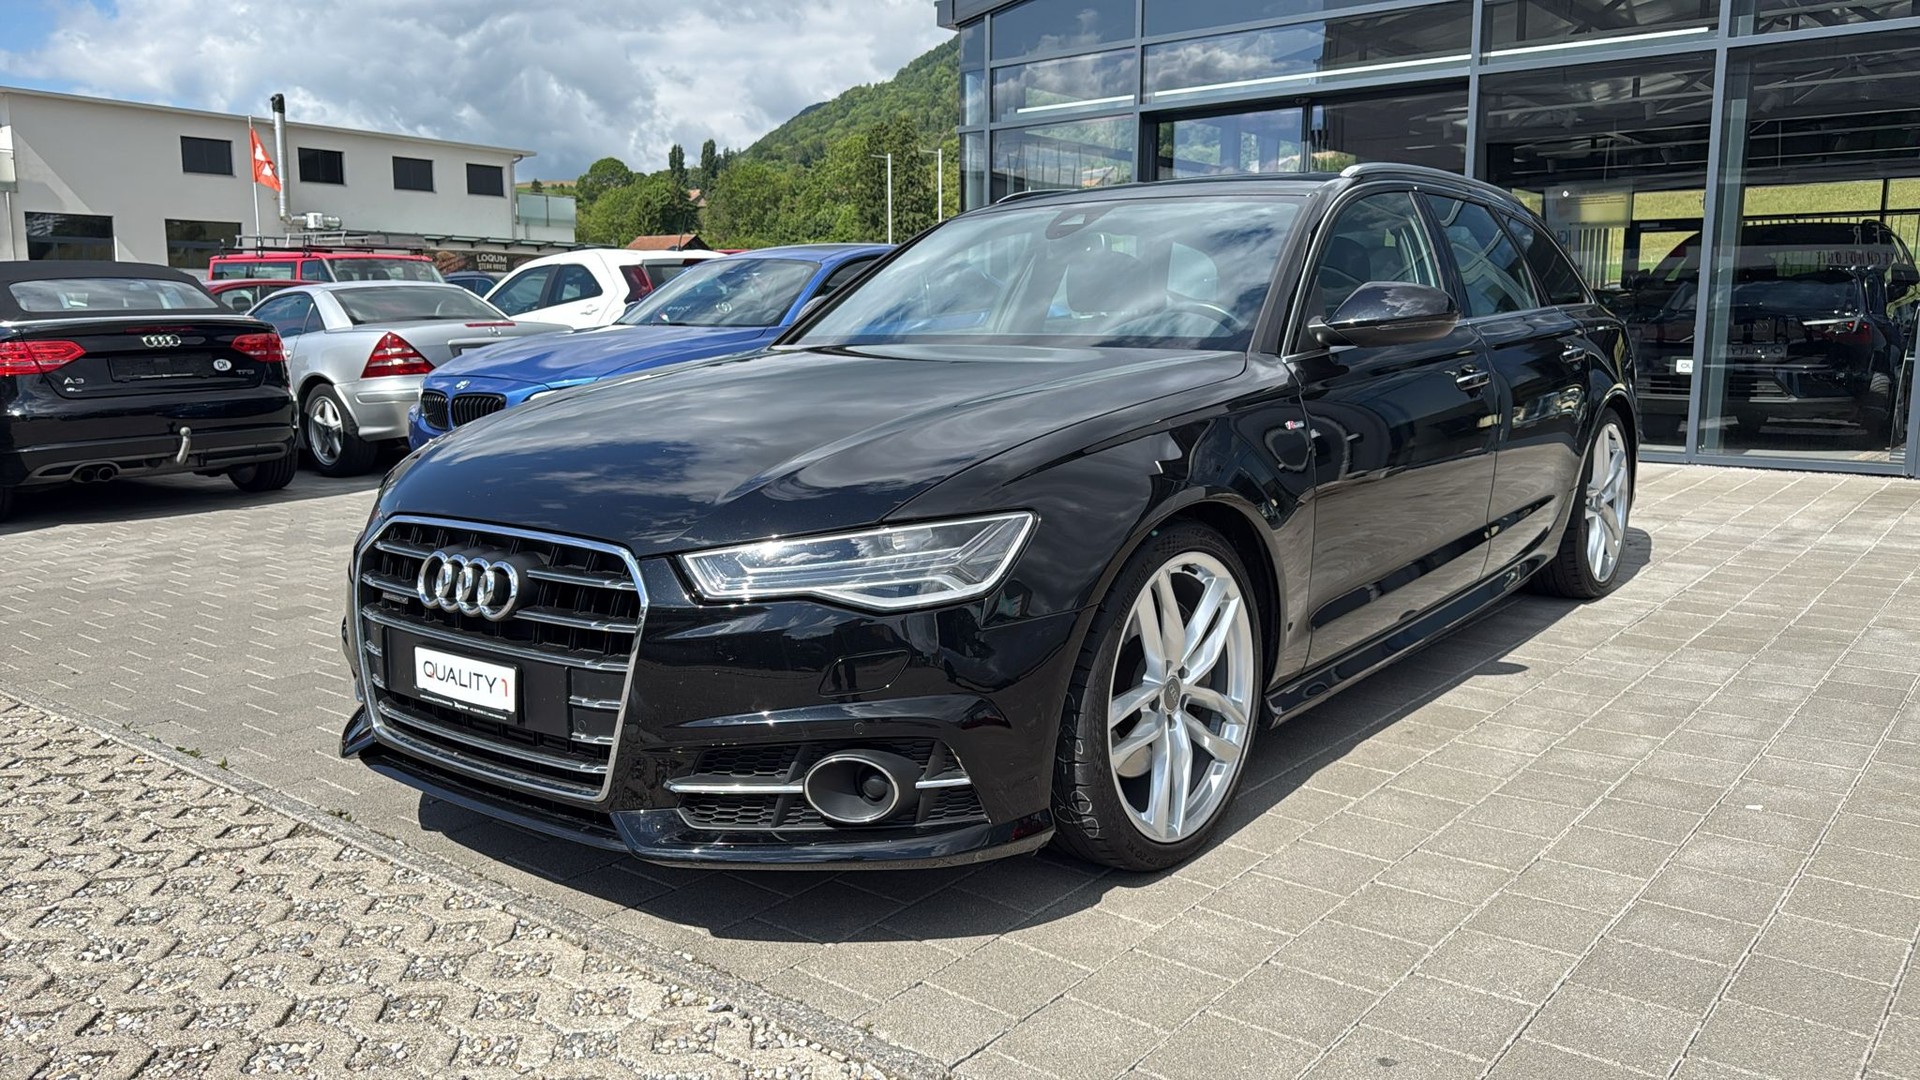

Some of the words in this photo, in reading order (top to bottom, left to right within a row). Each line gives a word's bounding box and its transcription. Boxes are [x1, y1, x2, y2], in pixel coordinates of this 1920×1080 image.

[476, 253, 508, 263] LOQUM
[478, 262, 493, 271] STEAK
[493, 263, 507, 272] HOUSE
[217, 361, 229, 370] CH
[64, 377, 85, 385] A3
[423, 660, 497, 694] QUALITY
[501, 678, 508, 697] 1
